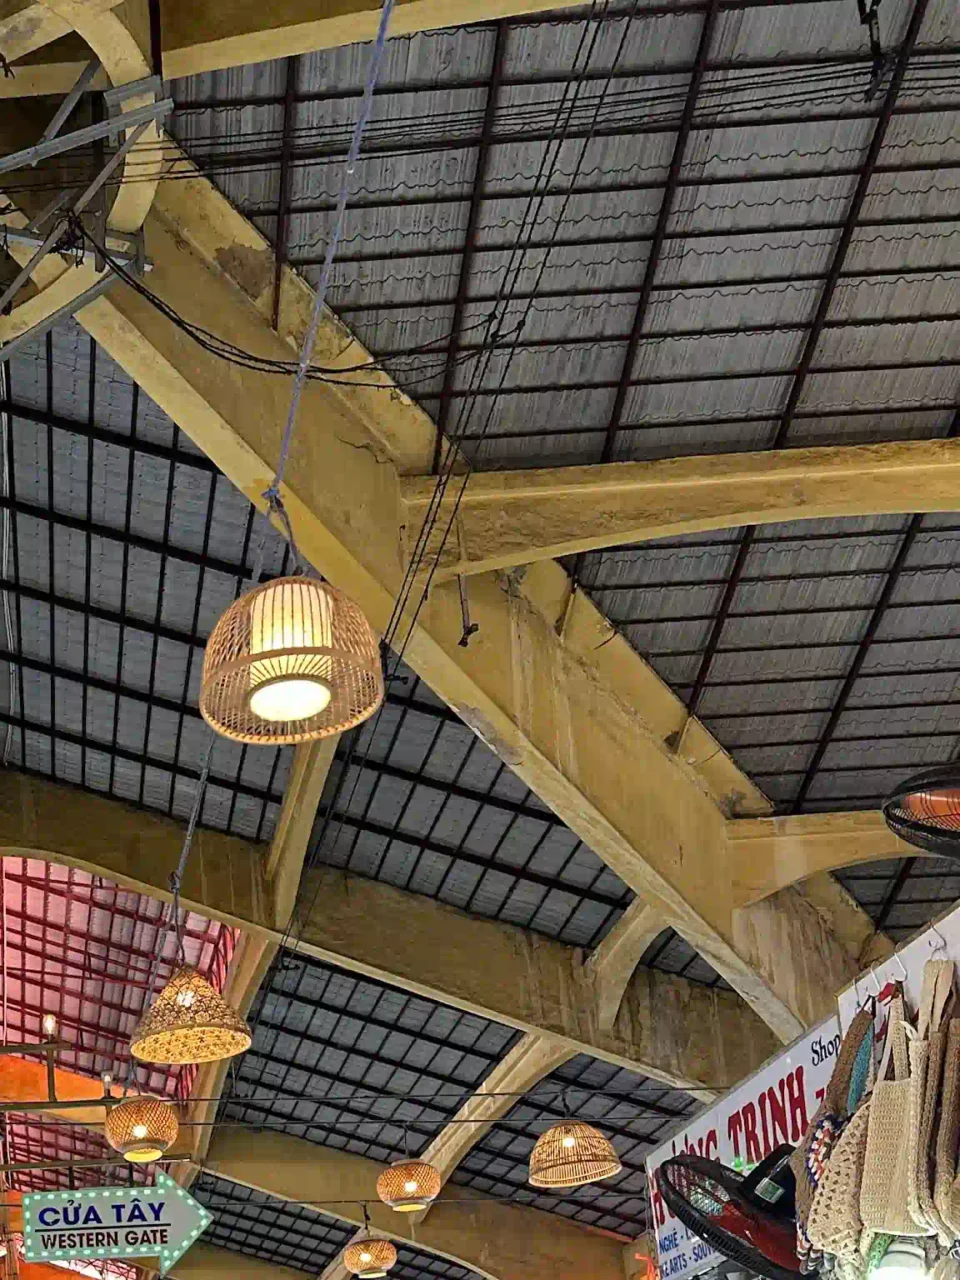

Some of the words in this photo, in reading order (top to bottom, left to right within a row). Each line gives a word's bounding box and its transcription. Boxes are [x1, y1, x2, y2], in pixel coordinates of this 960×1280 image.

[811, 1034, 840, 1066] Shop
[38, 1200, 102, 1226] CỬA
[111, 1198, 165, 1223] TÂY
[41, 1231, 119, 1249] WESTERN
[125, 1229, 169, 1246] GATE
